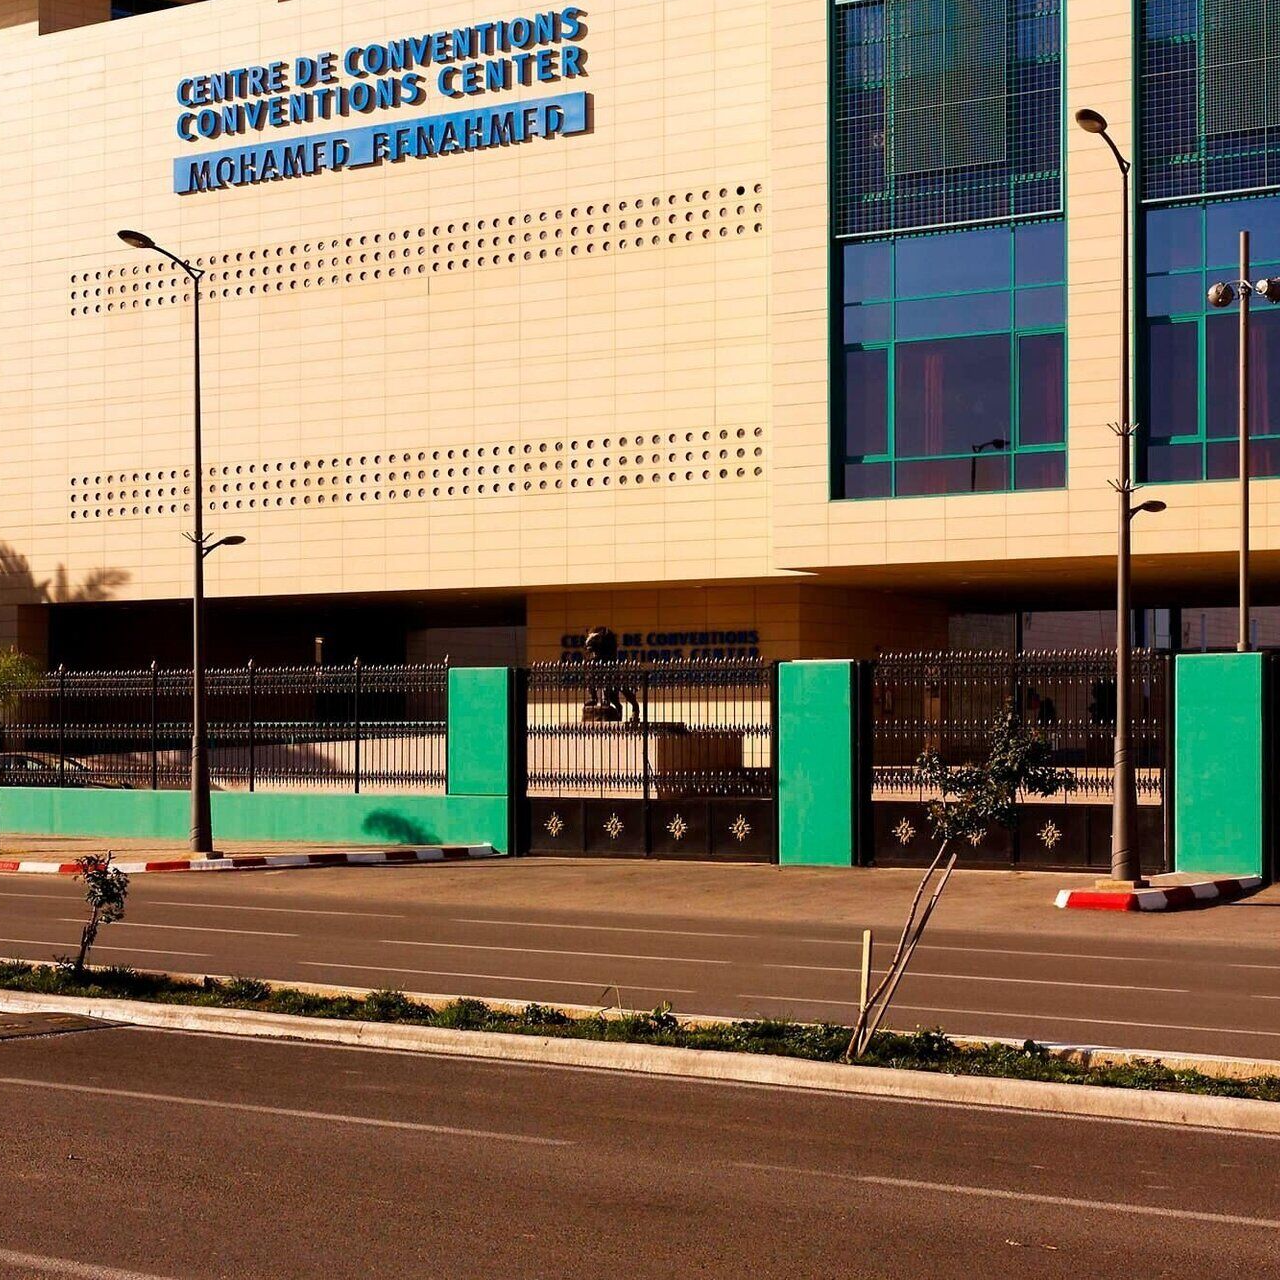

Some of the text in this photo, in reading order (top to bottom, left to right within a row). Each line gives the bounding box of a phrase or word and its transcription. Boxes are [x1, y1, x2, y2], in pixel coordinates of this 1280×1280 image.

[176, 6, 585, 108] CENTRE DE CONVENTIONS
[176, 45, 586, 141] CONVENTIONS CENTER
[188, 104, 566, 193] MOHAMED BENAHMED
[646, 630, 759, 646] CONVENTIONS
